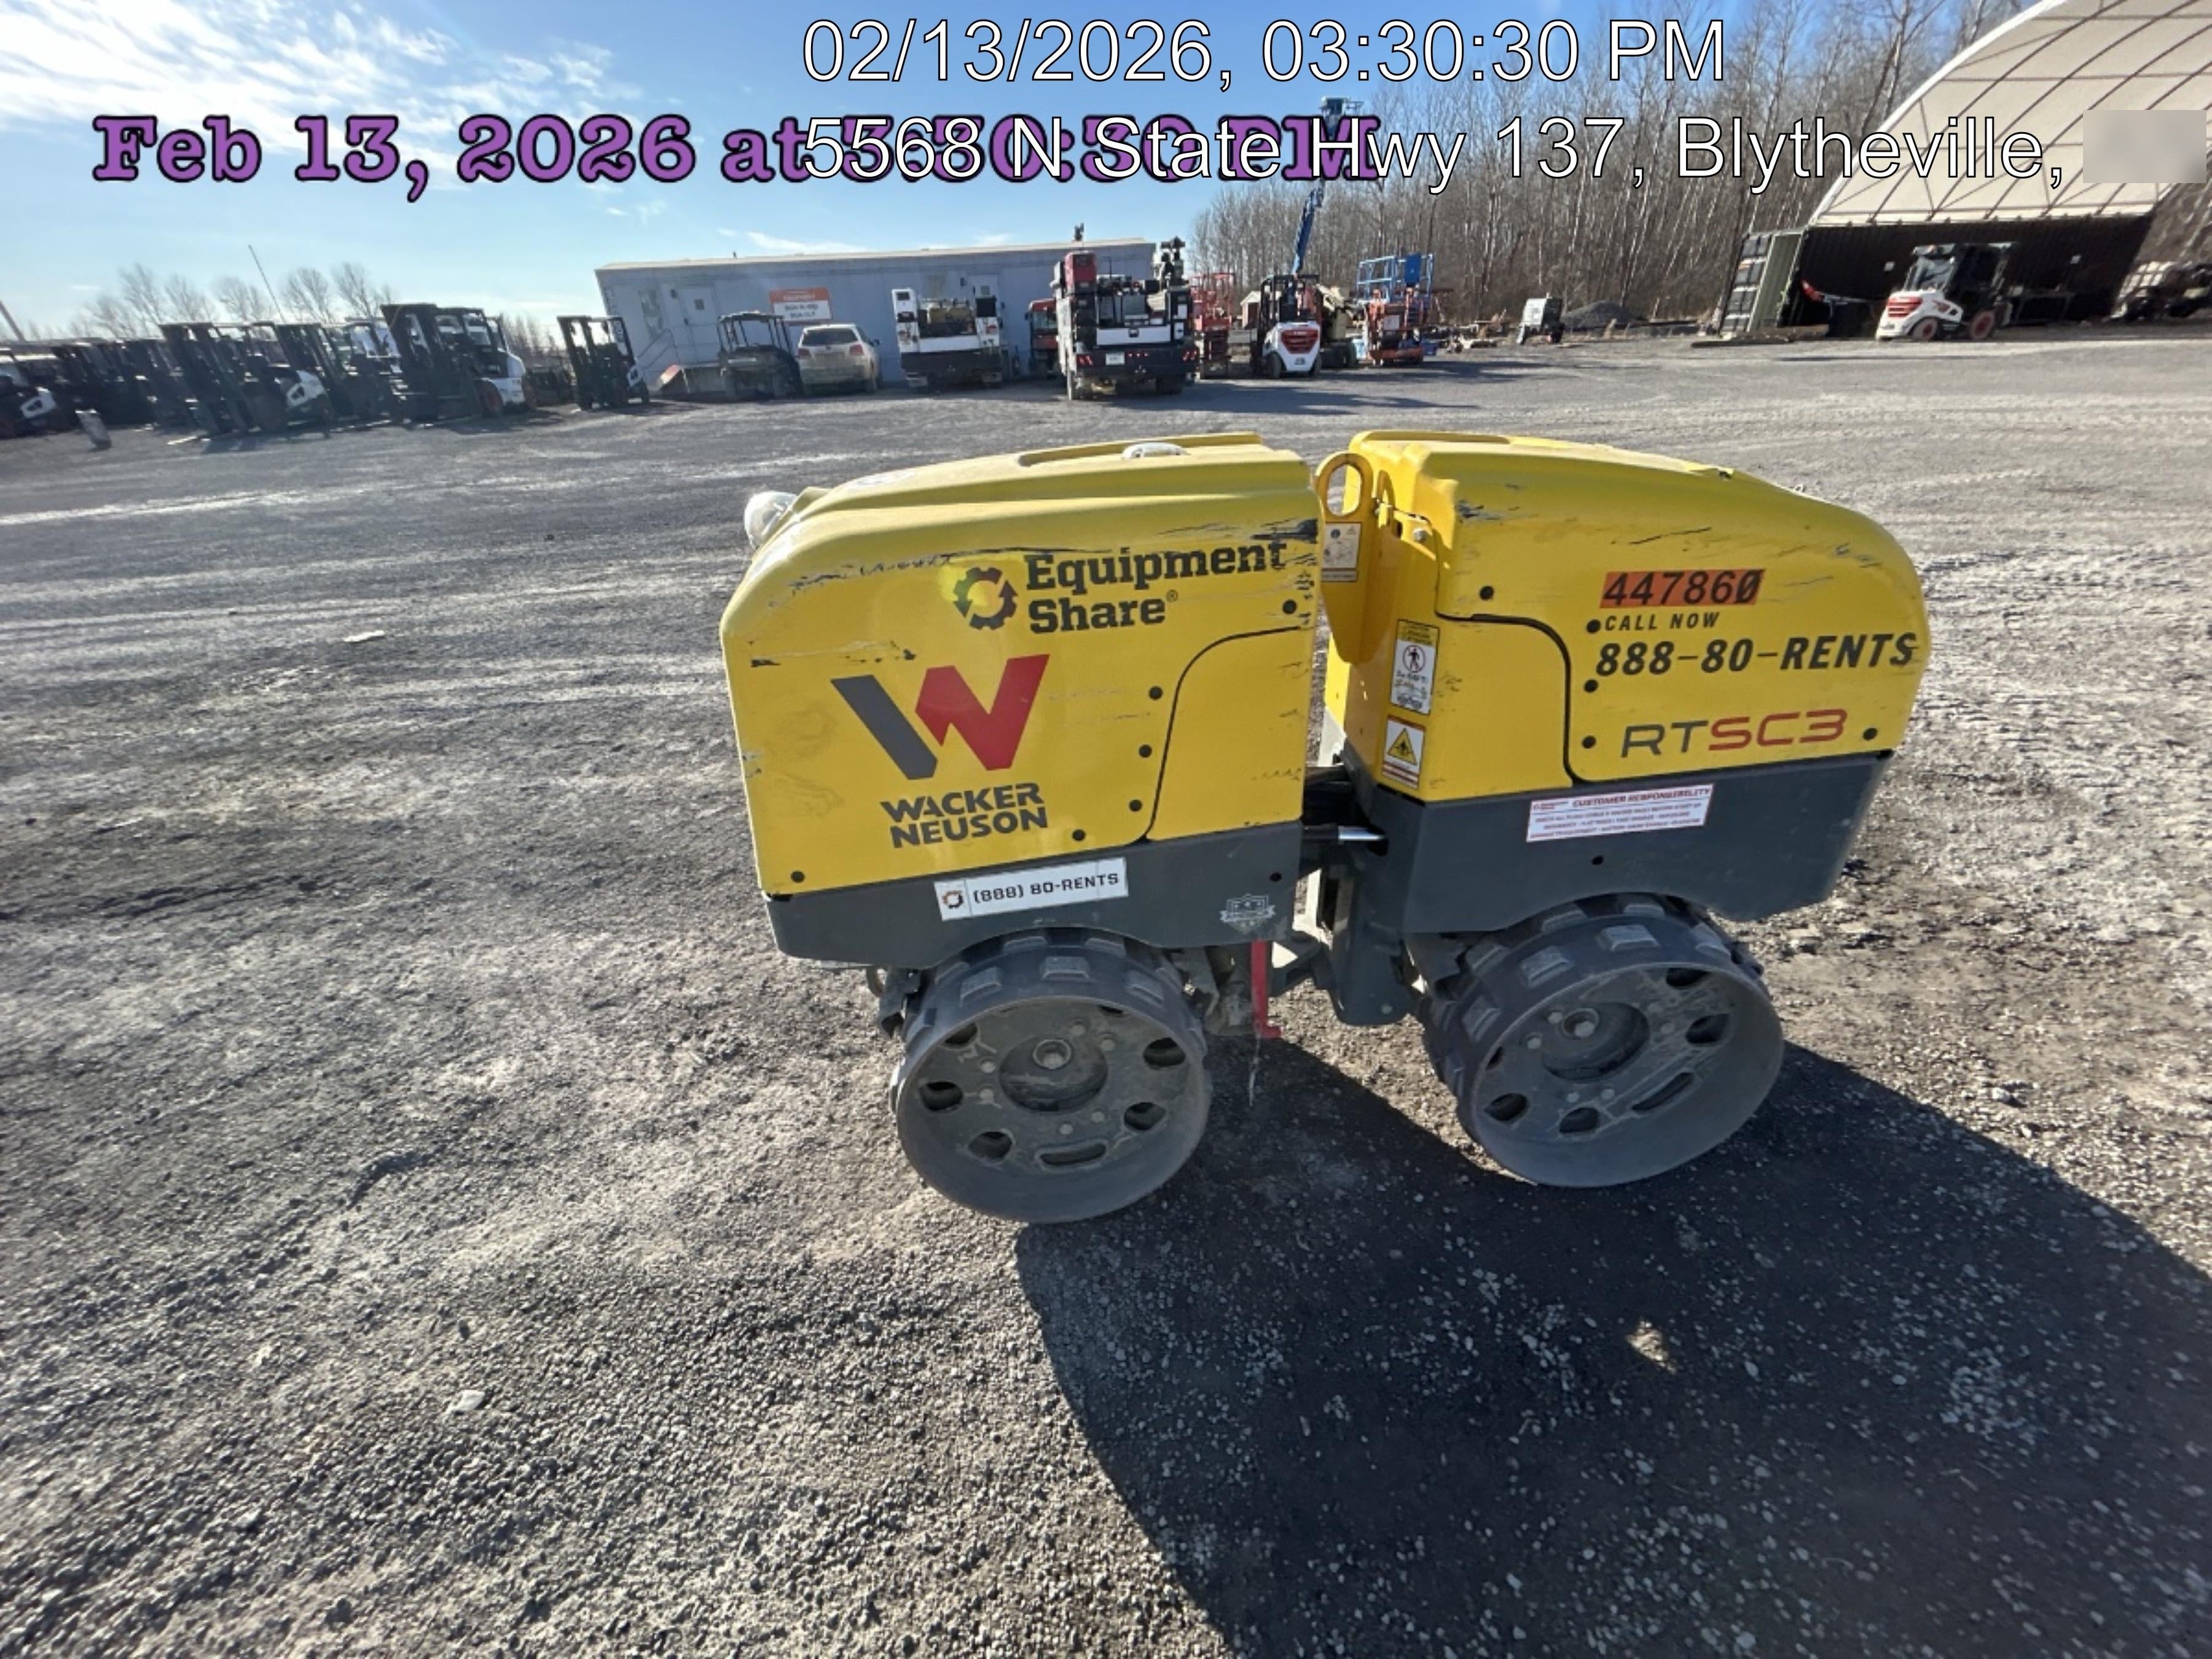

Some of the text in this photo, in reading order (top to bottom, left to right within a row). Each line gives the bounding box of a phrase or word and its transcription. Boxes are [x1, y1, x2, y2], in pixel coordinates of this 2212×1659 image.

[1024, 541, 1288, 595] Equipment
[1601, 569, 1766, 606] 447860
[1604, 612, 1720, 632] CALL NOW
[1595, 632, 1919, 677] 888-80-RENTS
[1620, 708, 1848, 758] RTSC3
[879, 782, 1045, 823] WACKER
[889, 806, 1048, 849] NEUSON
[973, 873, 1119, 904] (888) 80-RENTS
